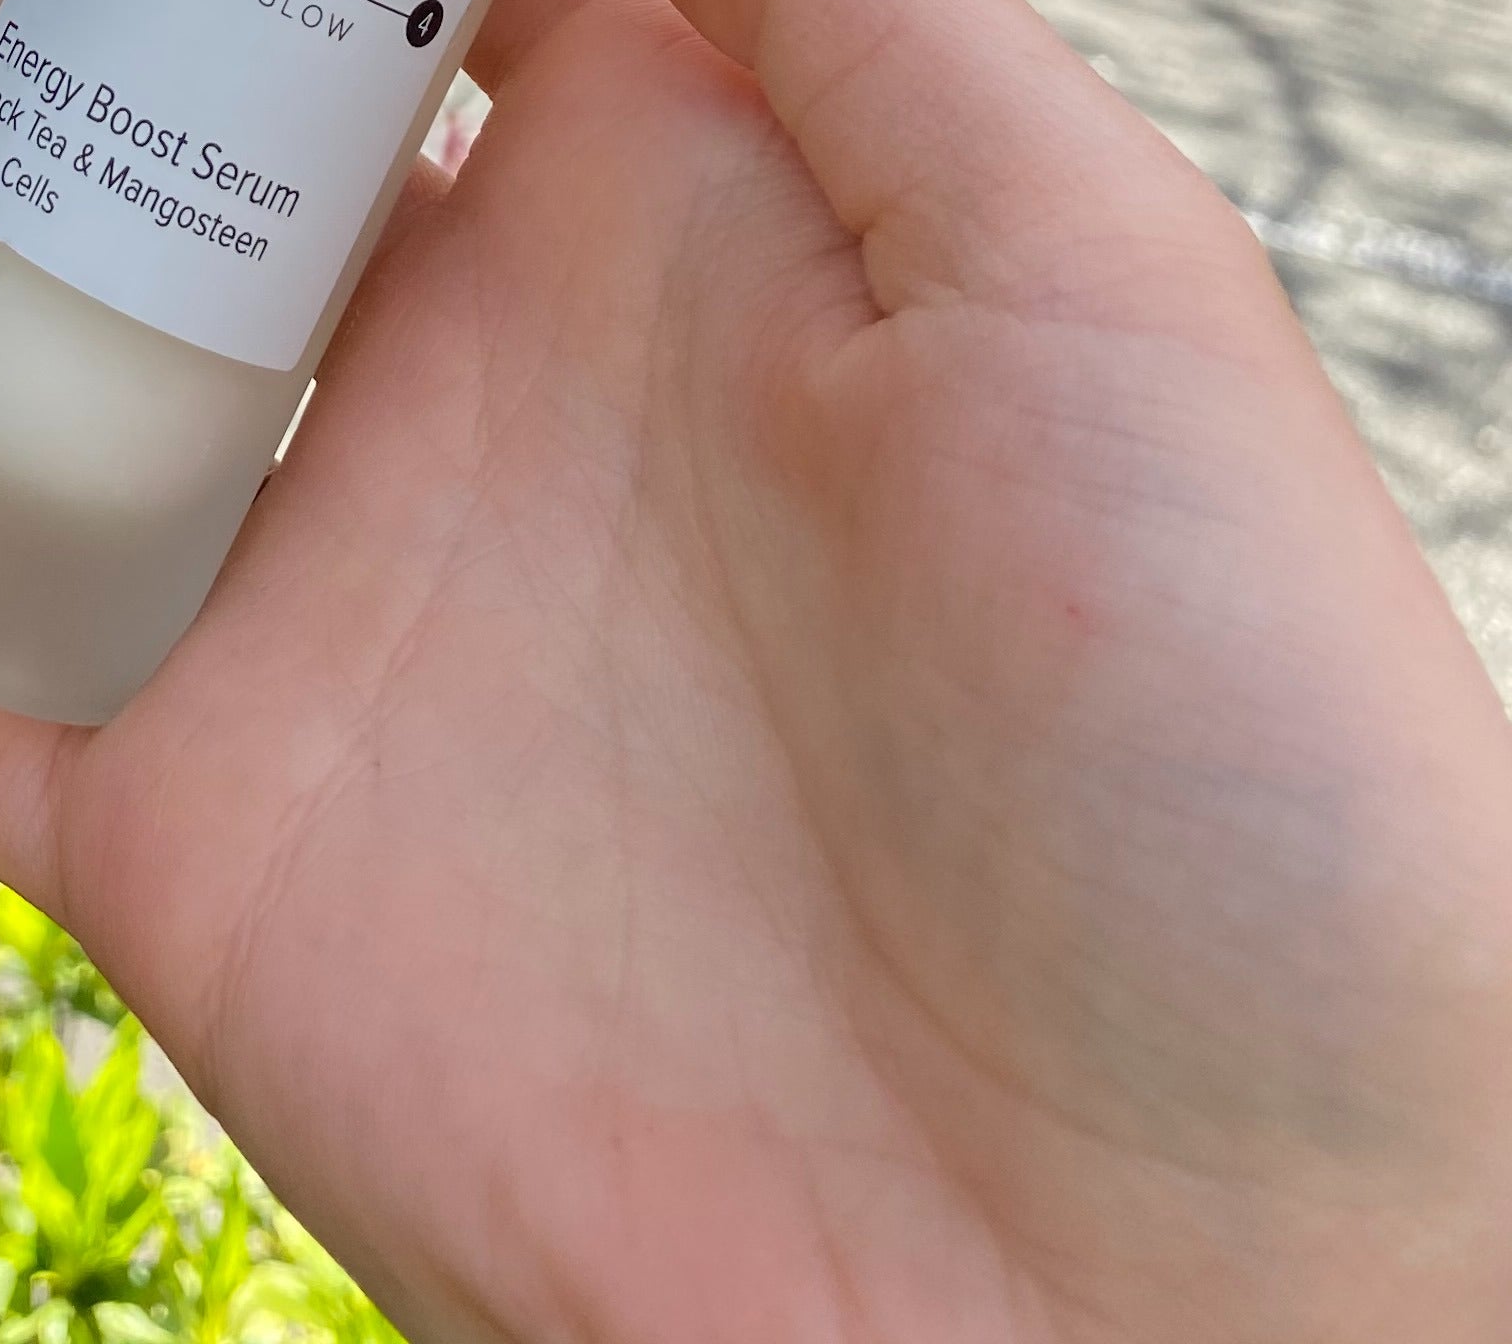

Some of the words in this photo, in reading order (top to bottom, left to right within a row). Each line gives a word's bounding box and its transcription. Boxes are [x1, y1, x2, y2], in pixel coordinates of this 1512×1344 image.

[418, 13, 432, 37] 4
[0, 156, 59, 215] Cells
[29, 110, 67, 159] Tea
[74, 143, 94, 175] &
[99, 157, 270, 261] Mangosteen
[87, 84, 189, 166] Boost
[192, 142, 301, 219] Serum
